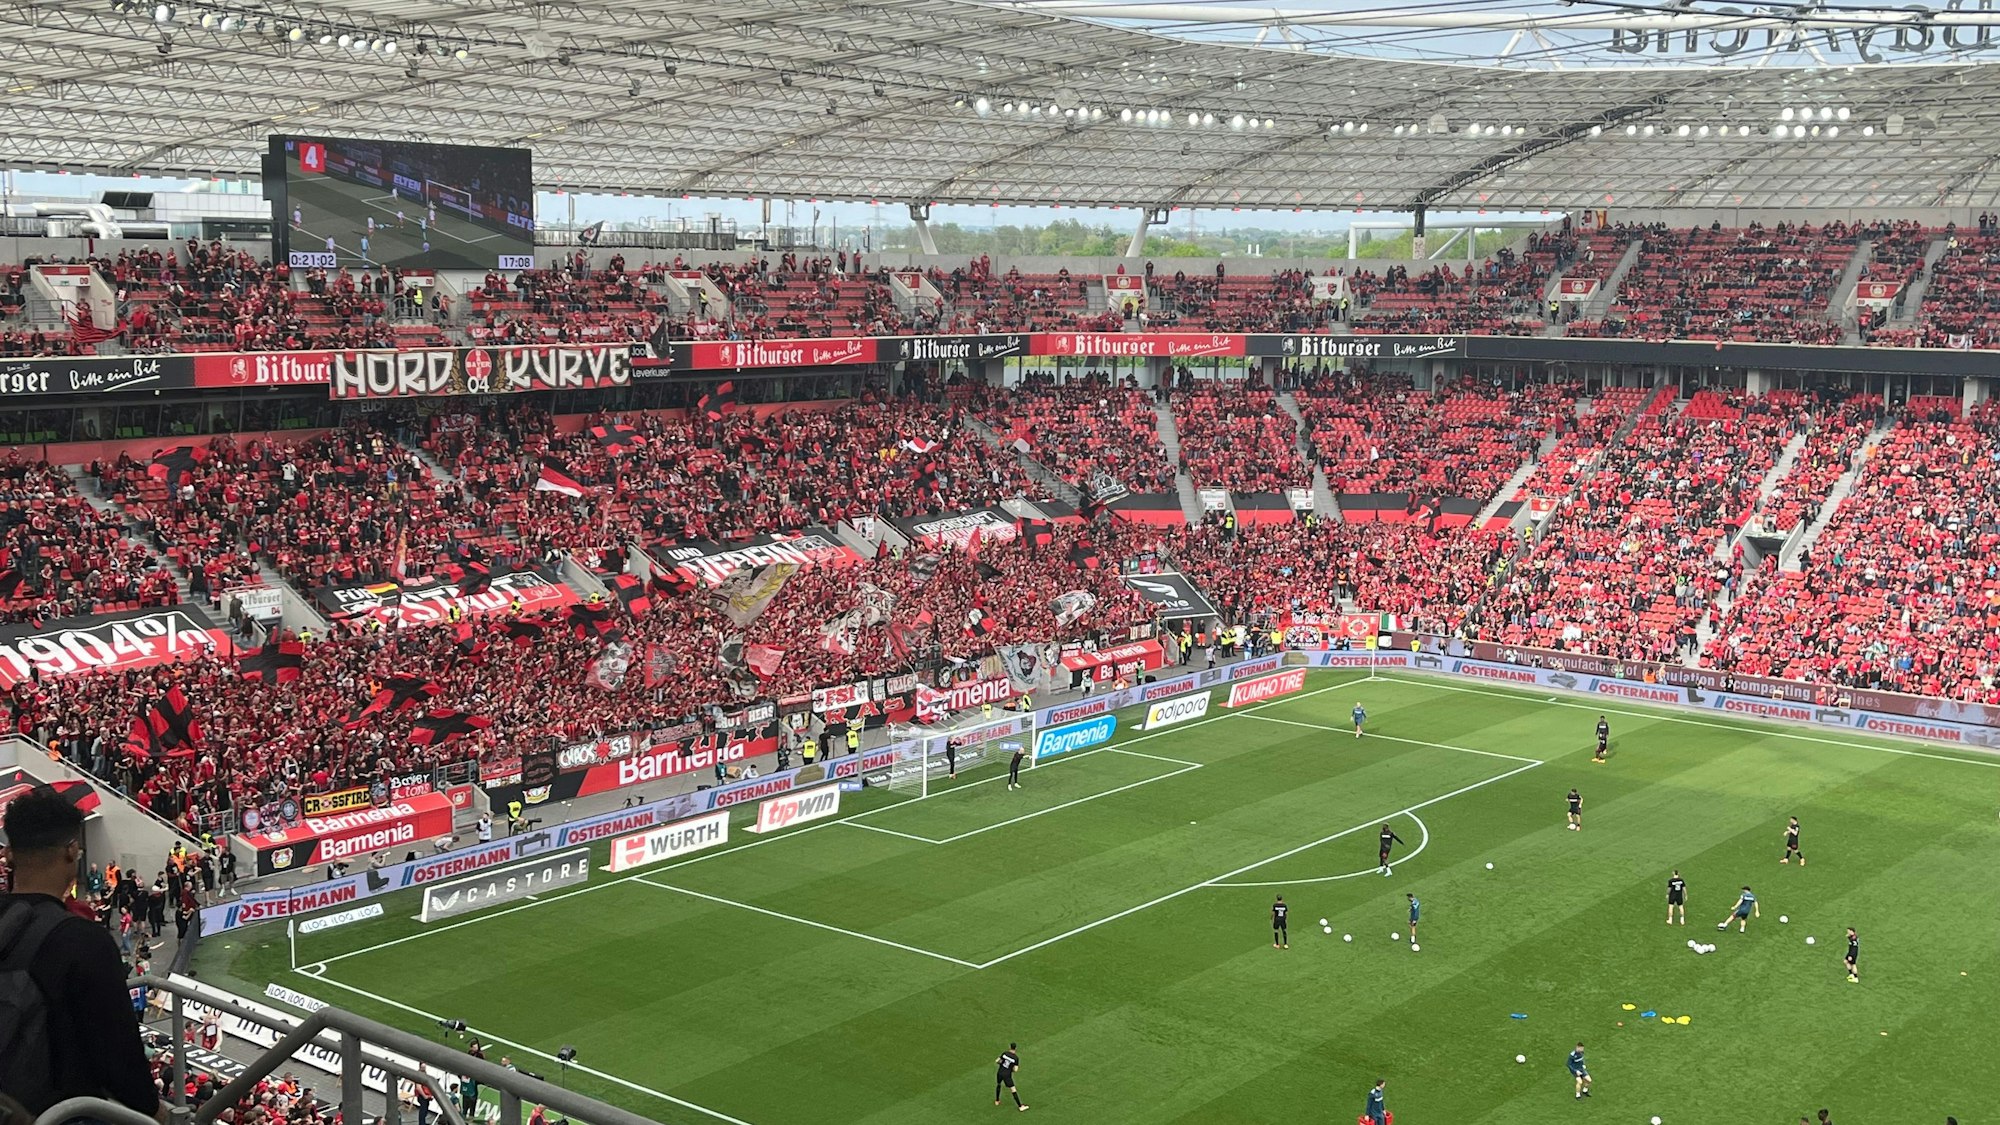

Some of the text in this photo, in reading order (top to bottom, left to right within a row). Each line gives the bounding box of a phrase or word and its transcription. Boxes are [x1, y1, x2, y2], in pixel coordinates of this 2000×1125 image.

[304, 146, 318, 168] 4
[393, 173, 421, 192] ELTEN
[291, 253, 335, 266] 0:21:02
[503, 257, 531, 268] 17:08
[735, 343, 804, 367] Bitburger
[812, 341, 863, 363] Bitte ein Bit
[912, 338, 971, 360] Bitburger
[978, 336, 1021, 356] Bitte ein Bit
[1073, 334, 1156, 356] Bitburger
[1168, 336, 1230, 353] Bitte ein Bit
[1299, 336, 1381, 357] Bitburger
[1393, 337, 1456, 356] Bitte ein Bit
[107, 368, 132, 383] ein
[133, 359, 161, 376] Bit
[334, 351, 454, 397] NORD
[506, 347, 629, 389] KURVE
[467, 376, 490, 393] 04
[667, 547, 705, 561] UND
[334, 587, 378, 603] FÜR
[1100, 657, 1146, 680] Bamenia
[1233, 659, 1277, 679] OSTERMANN
[1331, 655, 1408, 667] OSTERMANN
[1462, 664, 1536, 684] OSTERMANN
[1626, 665, 1638, 676] of
[1735, 680, 1811, 700] compacting
[1146, 679, 1194, 699] OSTERMANN
[1233, 671, 1303, 703] KUMHO TIRE
[1599, 683, 1679, 703] OSTERMANN
[1052, 700, 1106, 724] OSTERMANN
[1156, 697, 1207, 722] odiporo
[1724, 699, 1811, 721] OSTERMANN
[1041, 719, 1109, 755] Barmenia
[1867, 717, 1961, 741] OSTERMANN
[835, 750, 903, 777] OSTRMANN
[717, 777, 791, 806] OSTERMANN
[305, 801, 416, 835] Barmenia
[767, 791, 835, 827] tipwin
[568, 811, 654, 845] OSTERMANN
[320, 821, 415, 861] Barmenia
[413, 846, 511, 884] OSTERMANN
[466, 857, 588, 904] CASTORE
[239, 884, 357, 923] OSTERMANN
[304, 905, 380, 931] iLOQ iLOQ iLOQ
[267, 984, 287, 1000] iLOQ
[287, 991, 306, 1008] iLOQ
[185, 1049, 247, 1077] CAST
